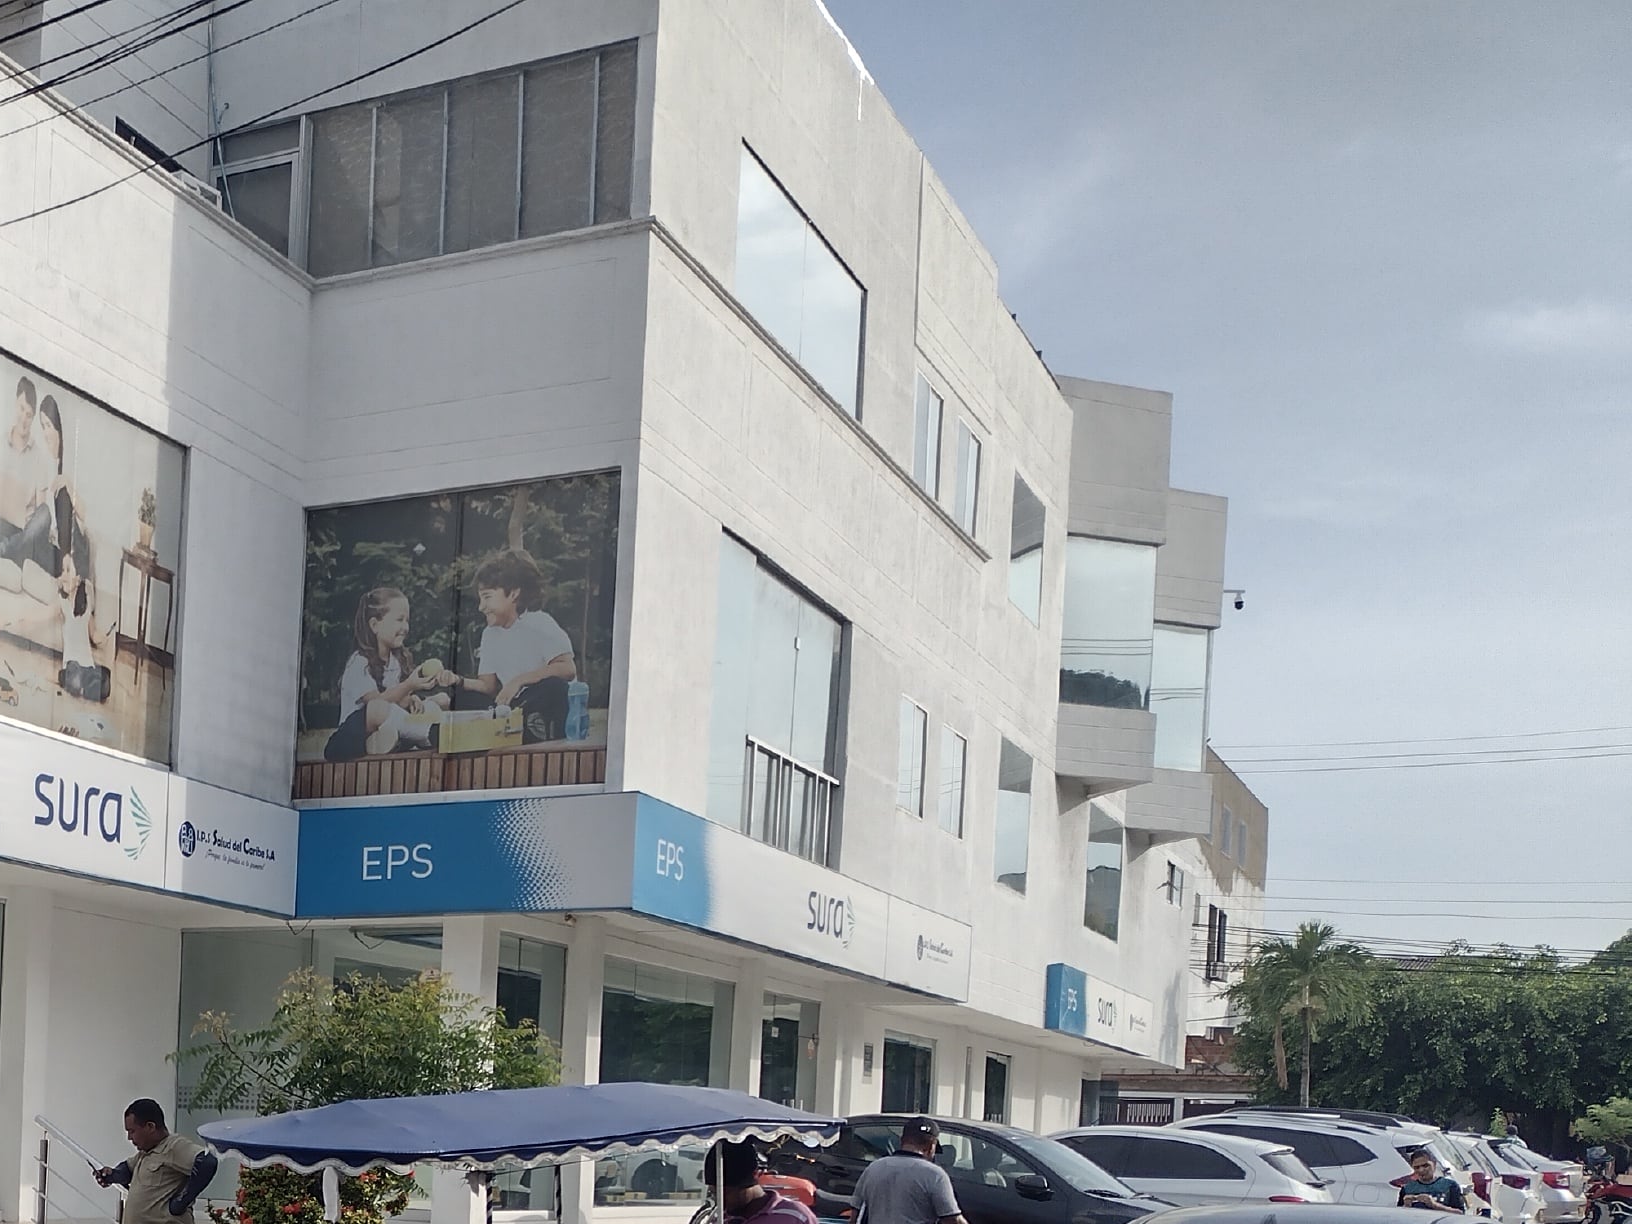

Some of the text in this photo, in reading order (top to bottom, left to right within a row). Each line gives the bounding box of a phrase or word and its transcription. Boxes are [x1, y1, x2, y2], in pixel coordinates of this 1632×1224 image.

[34, 773, 122, 843] sura
[213, 829, 231, 849] Salud
[232, 840, 242, 852] del
[243, 838, 265, 858] Caribe
[362, 843, 433, 880] EPS
[656, 838, 684, 881] EPS
[807, 891, 844, 938] sura
